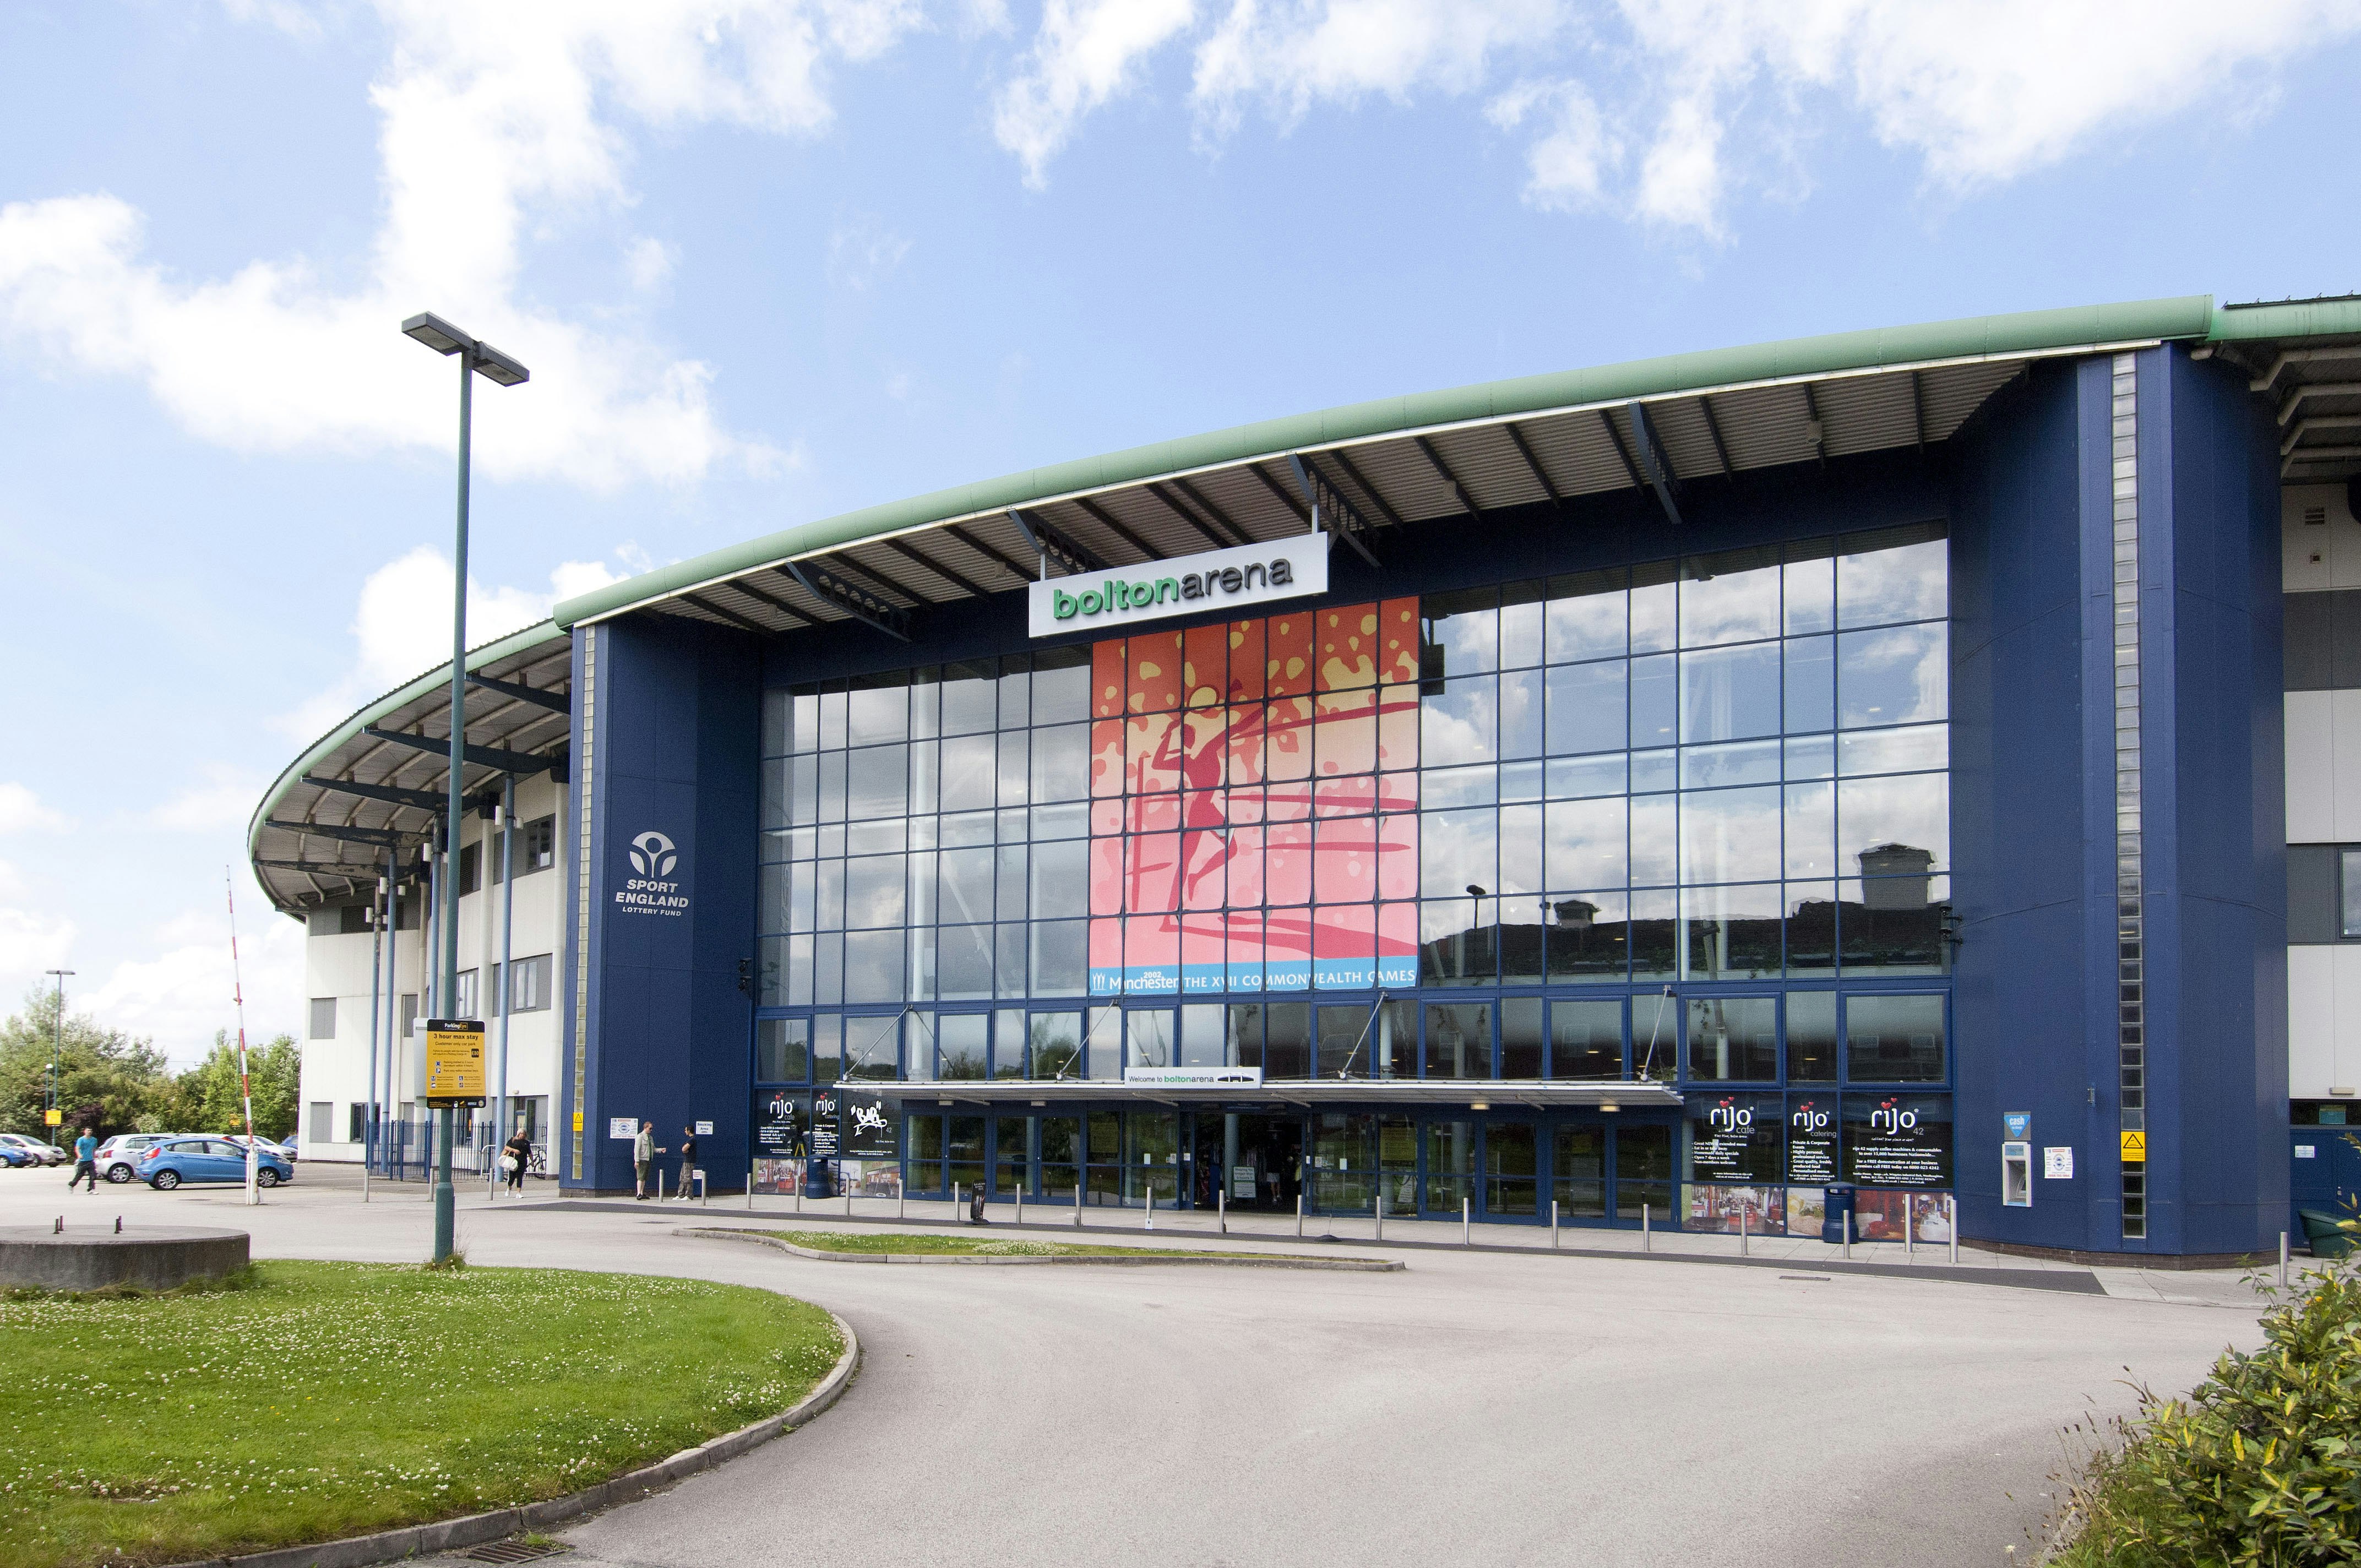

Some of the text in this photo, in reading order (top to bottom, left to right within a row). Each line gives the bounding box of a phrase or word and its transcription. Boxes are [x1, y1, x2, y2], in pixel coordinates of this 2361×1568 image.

[1053, 558, 1293, 619] boltonarena
[627, 879, 678, 893] SPORT
[615, 892, 689, 908] ENGLAND
[622, 906, 658, 914] LOTTERY
[1109, 975, 1178, 989] Mnchester
[1185, 977, 1207, 987] THE
[770, 1096, 793, 1119] rijo
[815, 1096, 835, 1115] rijo
[1710, 1102, 1751, 1132] rijo
[1793, 1106, 1827, 1132] rijo
[1872, 1103, 1915, 1135] rijo
[2009, 1115, 2025, 1125] cash
[1736, 1125, 1755, 1134] cafe
